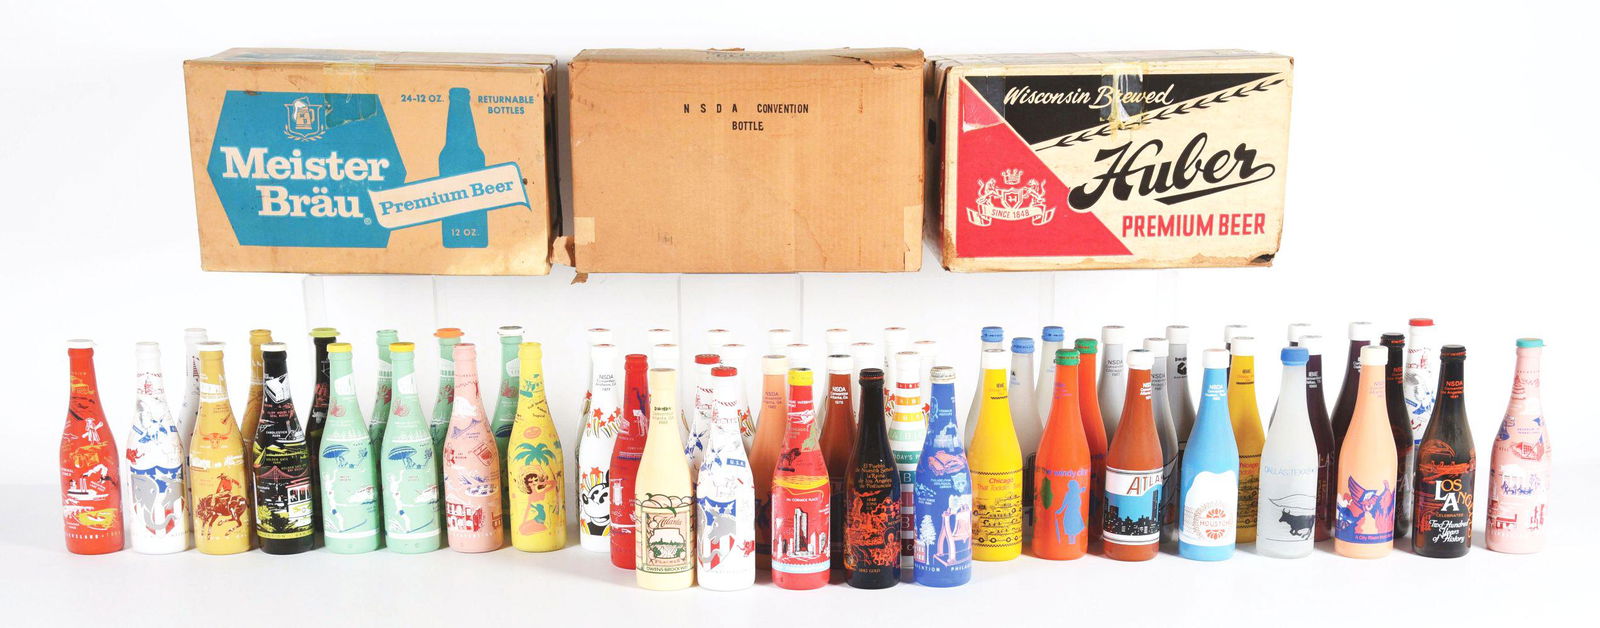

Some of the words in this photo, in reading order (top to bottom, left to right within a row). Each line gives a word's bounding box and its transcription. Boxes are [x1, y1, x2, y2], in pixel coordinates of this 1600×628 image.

[401, 94, 427, 103] 24-12
[428, 94, 445, 103] OZ.
[477, 95, 535, 104] RETURNABLE
[1003, 84, 1091, 107] Wisconsin
[487, 106, 525, 115] BOTTLES
[756, 103, 809, 114] CONVENTION
[732, 121, 765, 131] BOTTLE
[219, 145, 390, 182] Meister
[1068, 132, 1276, 211] Huber
[255, 184, 364, 218] Bräu
[380, 187, 468, 216] Premium
[471, 178, 514, 201] Beer
[991, 208, 1011, 218] SINCE
[1122, 213, 1215, 239] PREMIUM
[1218, 212, 1266, 237] BEER
[450, 228, 461, 237] 12
[462, 228, 480, 237] OZ.
